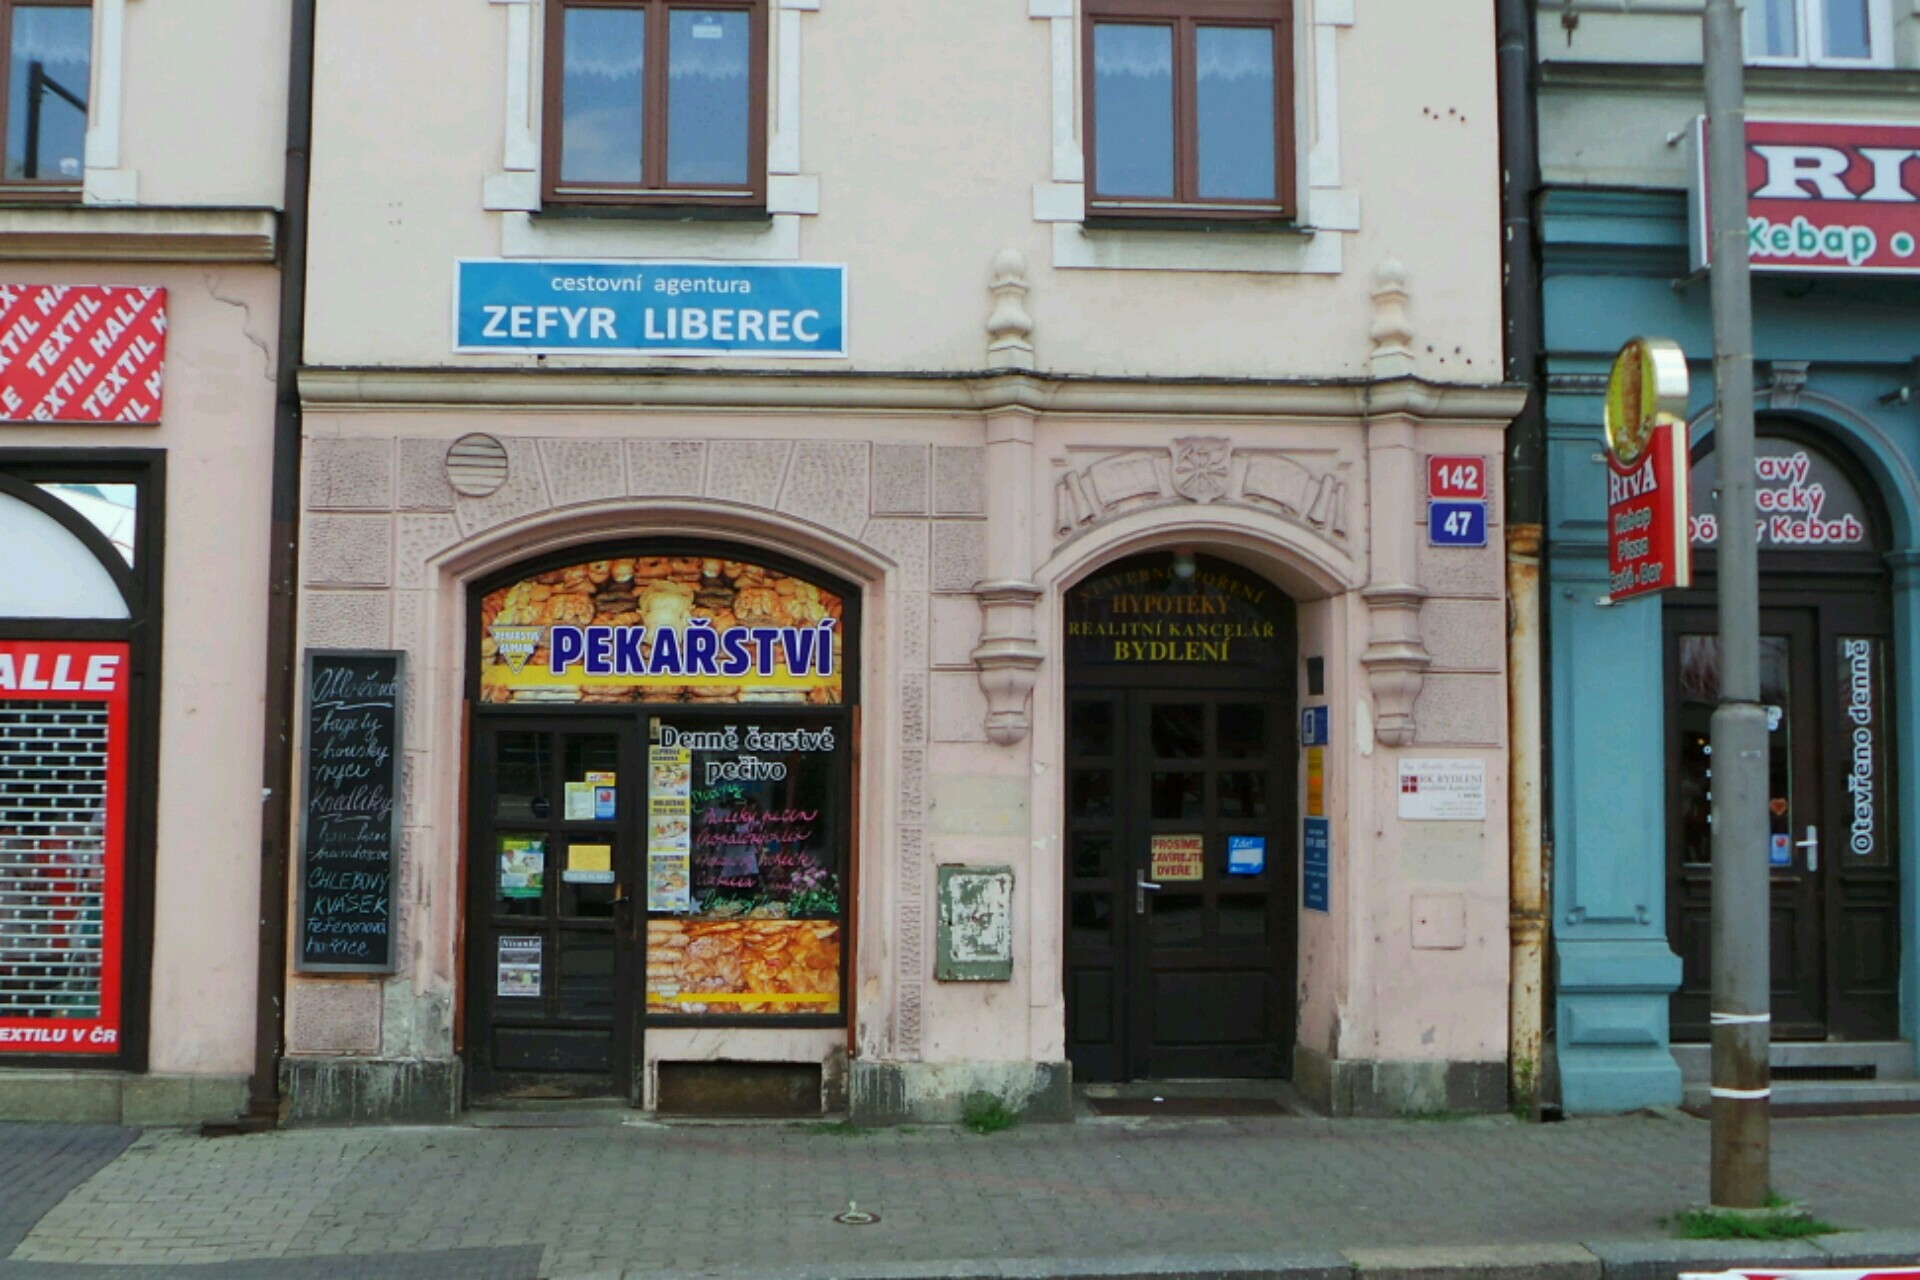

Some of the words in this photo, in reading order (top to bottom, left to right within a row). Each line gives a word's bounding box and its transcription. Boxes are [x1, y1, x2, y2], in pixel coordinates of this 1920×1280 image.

[1751, 145, 1920, 202] RI
[1748, 216, 1877, 266] Kebap
[551, 274, 642, 292] cestovní
[654, 276, 751, 295] agentura
[26, 294, 102, 378] TEXTIL
[482, 305, 617, 339] ZEFYR
[644, 307, 820, 342] LIBEREC
[27, 356, 96, 420] EXTIL
[82, 335, 157, 418] TEXTIL
[1438, 464, 1478, 490] 142
[1609, 453, 1658, 506] RIVA
[1757, 452, 1809, 484] avý
[1758, 483, 1825, 515] ecký
[1443, 510, 1472, 536] 47
[1770, 514, 1863, 544] Kebab
[1111, 590, 1230, 614] HYPOTÉKY
[1069, 620, 1163, 636] REALITNÍ
[1168, 621, 1275, 637] KANCELÁŘ
[550, 617, 836, 677] PEKAŘSTVÍ
[1113, 636, 1231, 661] BYDLENÍ
[1844, 638, 1872, 725] denně
[659, 726, 739, 751] Denně
[744, 726, 835, 751] čerstvé
[705, 756, 787, 786] pečivo
[1848, 727, 1873, 854] Otevřeno
[0, 1027, 68, 1042] EXTILU
[72, 1029, 87, 1042] V
[89, 1025, 118, 1043] ČR
